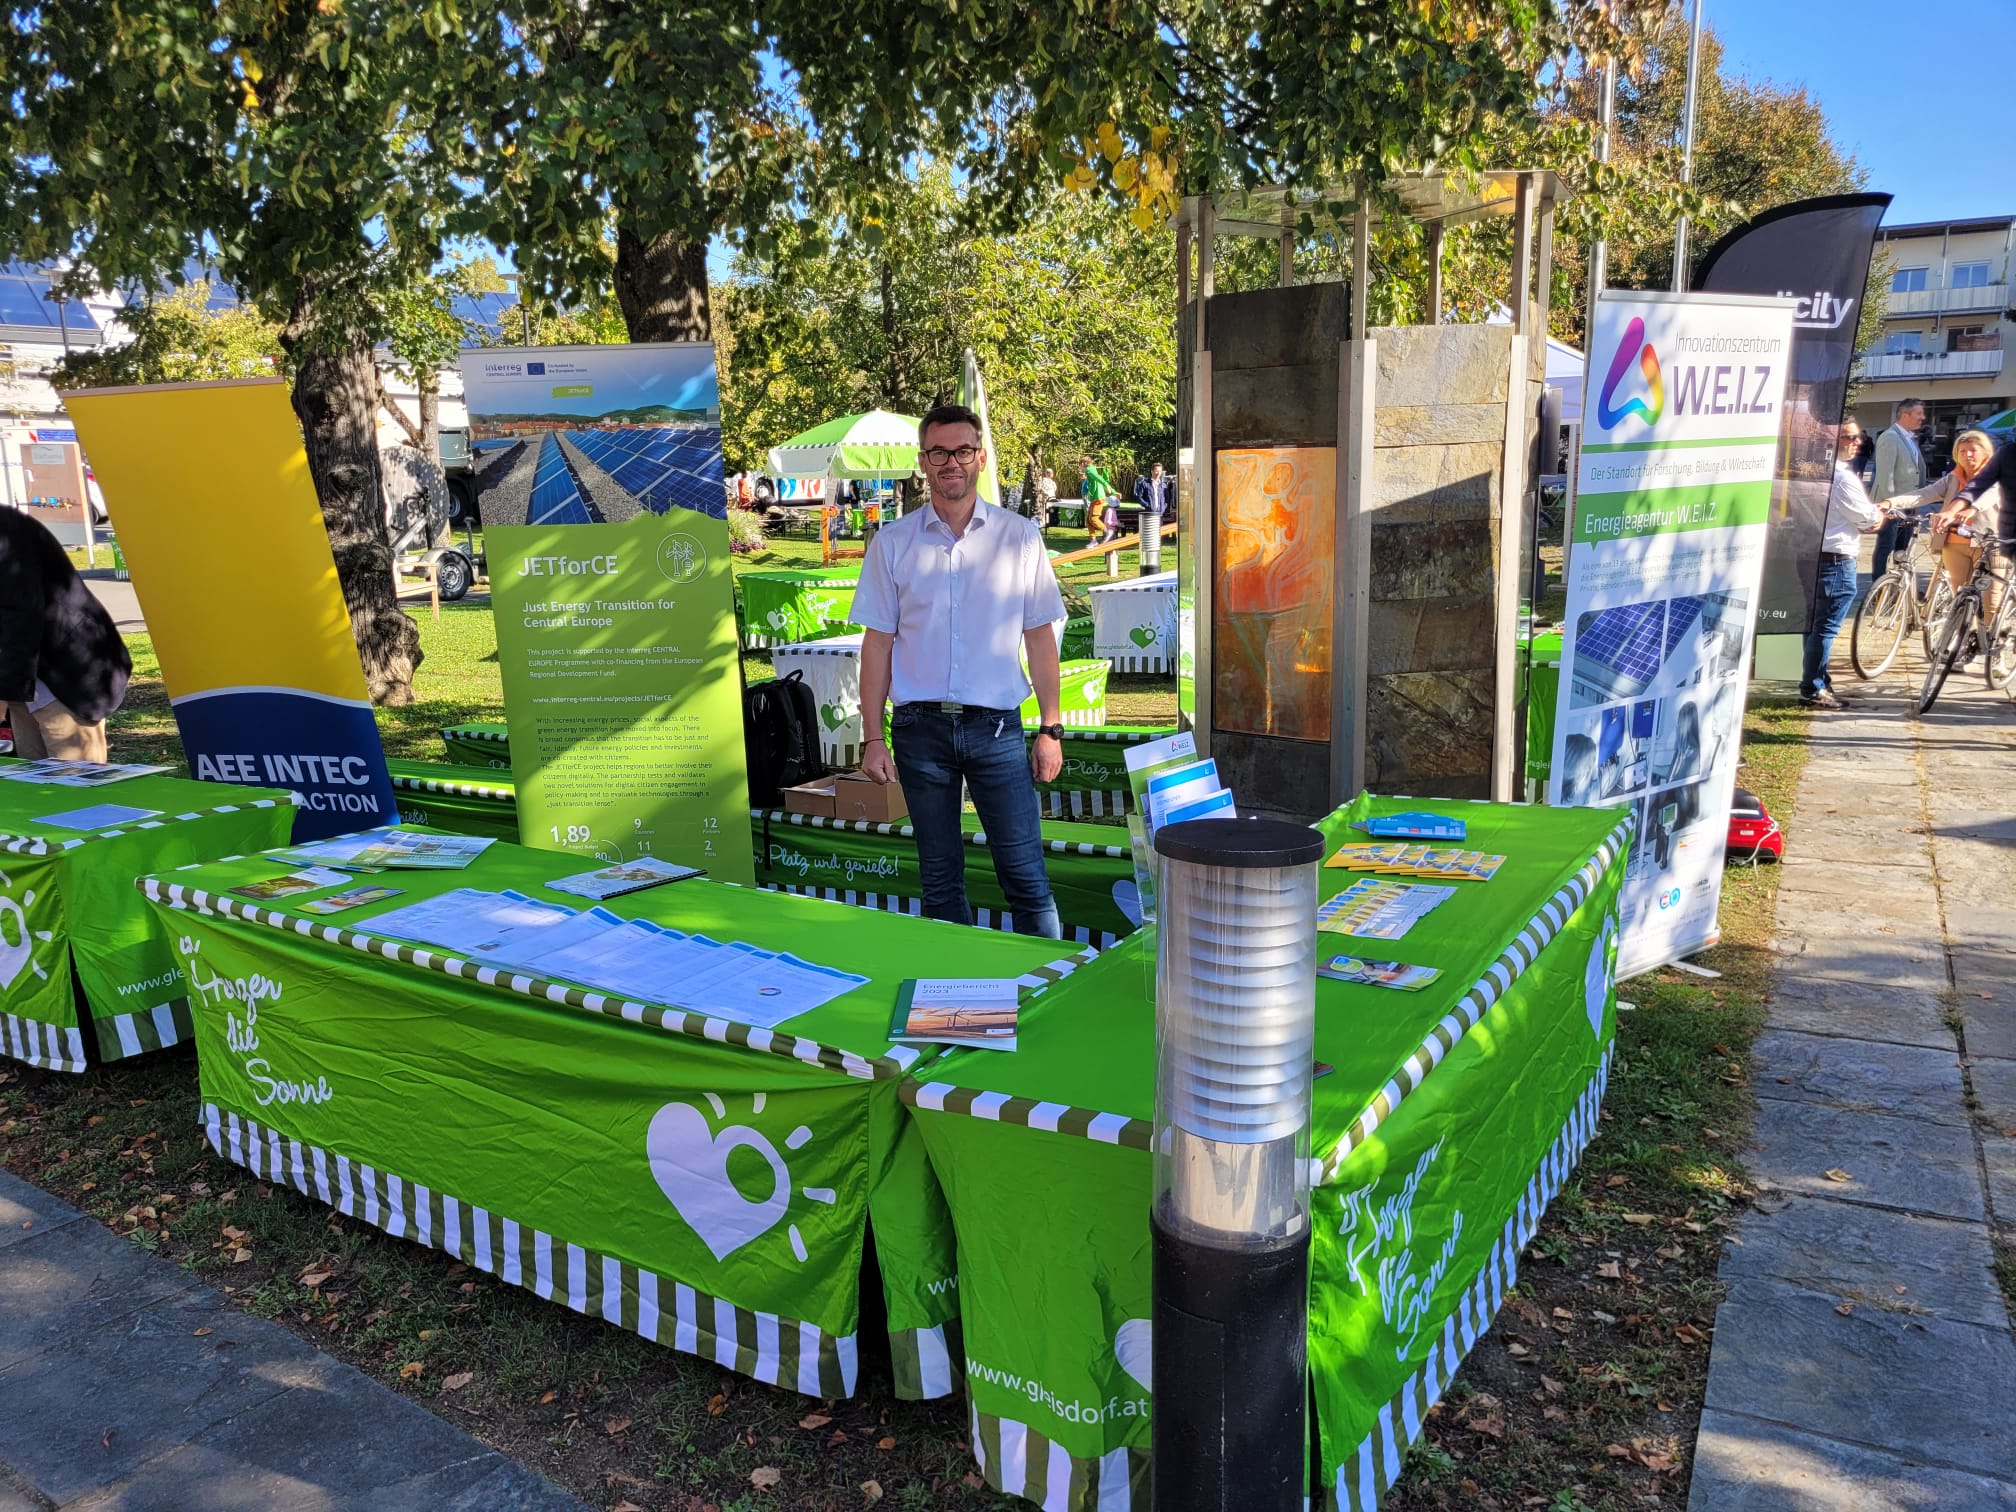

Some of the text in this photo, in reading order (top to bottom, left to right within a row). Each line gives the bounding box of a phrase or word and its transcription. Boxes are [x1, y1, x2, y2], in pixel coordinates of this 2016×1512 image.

[1777, 290, 1854, 328] city
[1674, 331, 1781, 353] Innovationszentrum
[1673, 365, 1773, 416] W.E.I.Z.
[1591, 456, 1766, 480] Der Standort für Forschung, Bildung & Wirtschaft
[1585, 502, 1717, 535] Energieagentur W.E.I.Z.
[517, 555, 619, 577] JETforCE
[522, 598, 676, 614] Just Energy Transition for
[524, 615, 613, 628] Central Europe
[572, 648, 604, 656] supported
[536, 716, 551, 724] With
[553, 716, 586, 724] increasing
[610, 716, 632, 724] prices,
[684, 734, 696, 742] just
[197, 753, 370, 786] AEE INTEC
[1064, 758, 1111, 783] Platz
[616, 782, 636, 790] digital
[299, 792, 380, 813] ACTION
[634, 818, 642, 828] 9
[703, 817, 718, 828] 12
[550, 825, 591, 847] 1,89
[637, 840, 650, 851] 11
[704, 840, 712, 851] 2
[769, 844, 899, 881] Platz und genieße!
[227, 1012, 259, 1053] die
[246, 1058, 333, 1106] Sonne
[1378, 1247, 1413, 1325] die
[1396, 1209, 1463, 1362] Sonne
[966, 1356, 1149, 1426] www.gleisdorf.at
